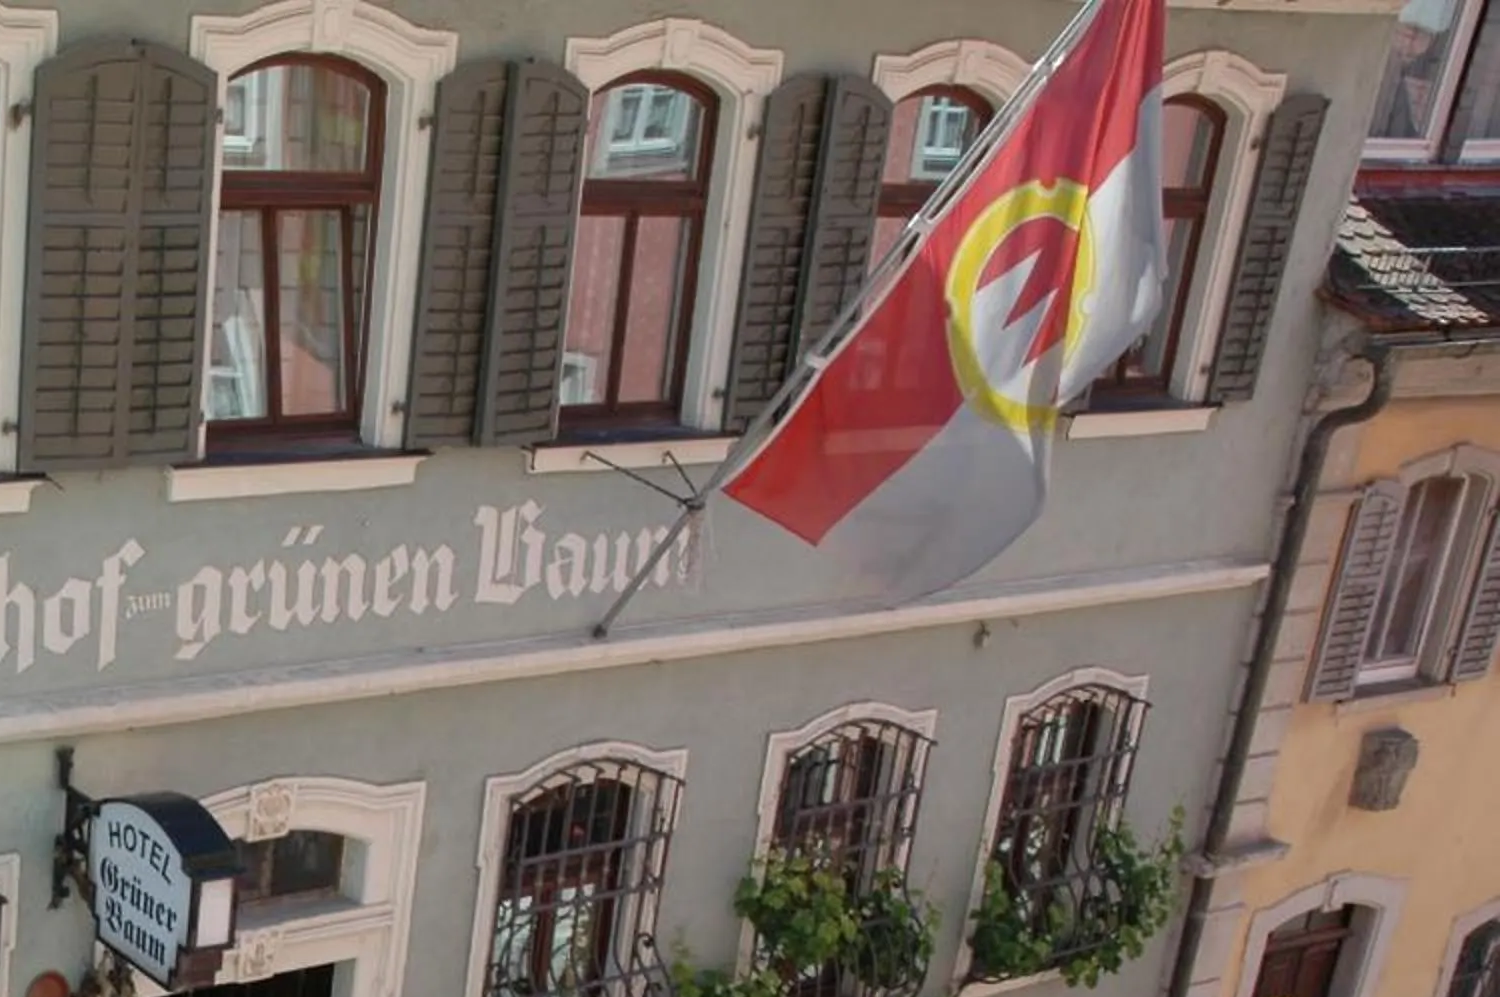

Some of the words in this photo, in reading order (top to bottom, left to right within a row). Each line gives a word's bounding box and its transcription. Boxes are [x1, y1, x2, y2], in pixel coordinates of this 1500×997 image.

[174, 525, 459, 660] grünen
[474, 499, 690, 604] Baum
[108, 821, 172, 885] HOTEL
[100, 856, 178, 932] Grüner
[105, 899, 166, 967] Baum
